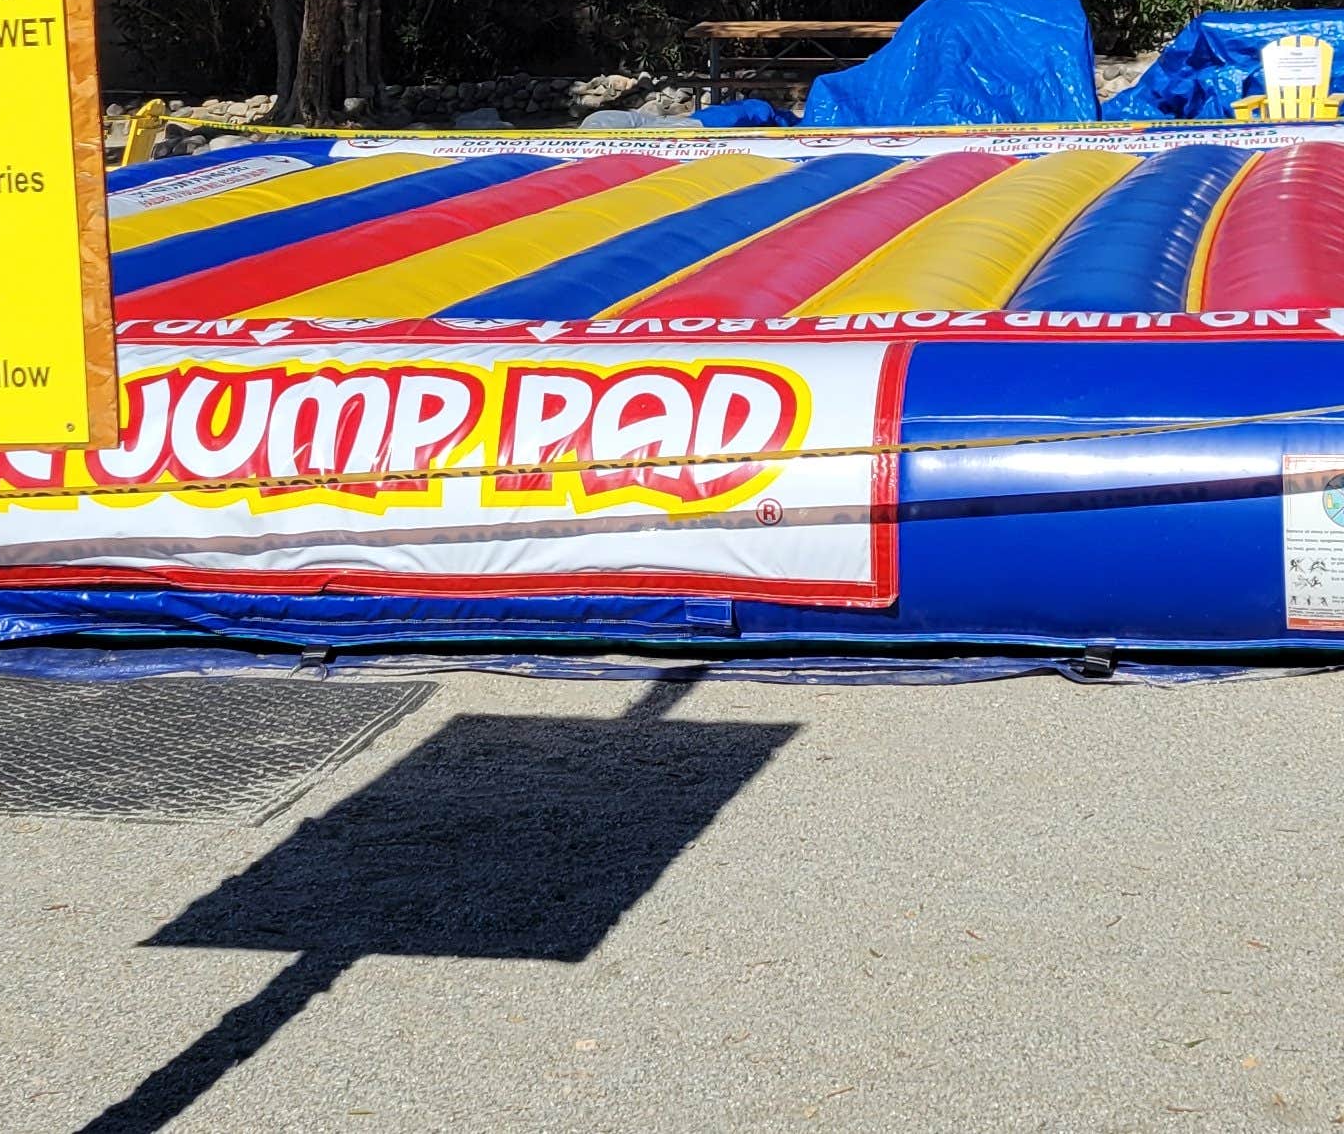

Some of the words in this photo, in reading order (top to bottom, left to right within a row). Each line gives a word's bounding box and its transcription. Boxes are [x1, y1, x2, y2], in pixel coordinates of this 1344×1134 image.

[537, 140, 590, 148] JUMP
[1028, 136, 1067, 144] NOT
[1136, 133, 1205, 142] ALONG
[1212, 130, 1278, 138] EDGES
[585, 316, 805, 334] ABOVE
[817, 309, 991, 332] ZONE
[1004, 308, 1180, 329] JUMP
[1200, 308, 1299, 328] NO
[99, 373, 474, 488] JUMP
[506, 372, 783, 488] PAD
